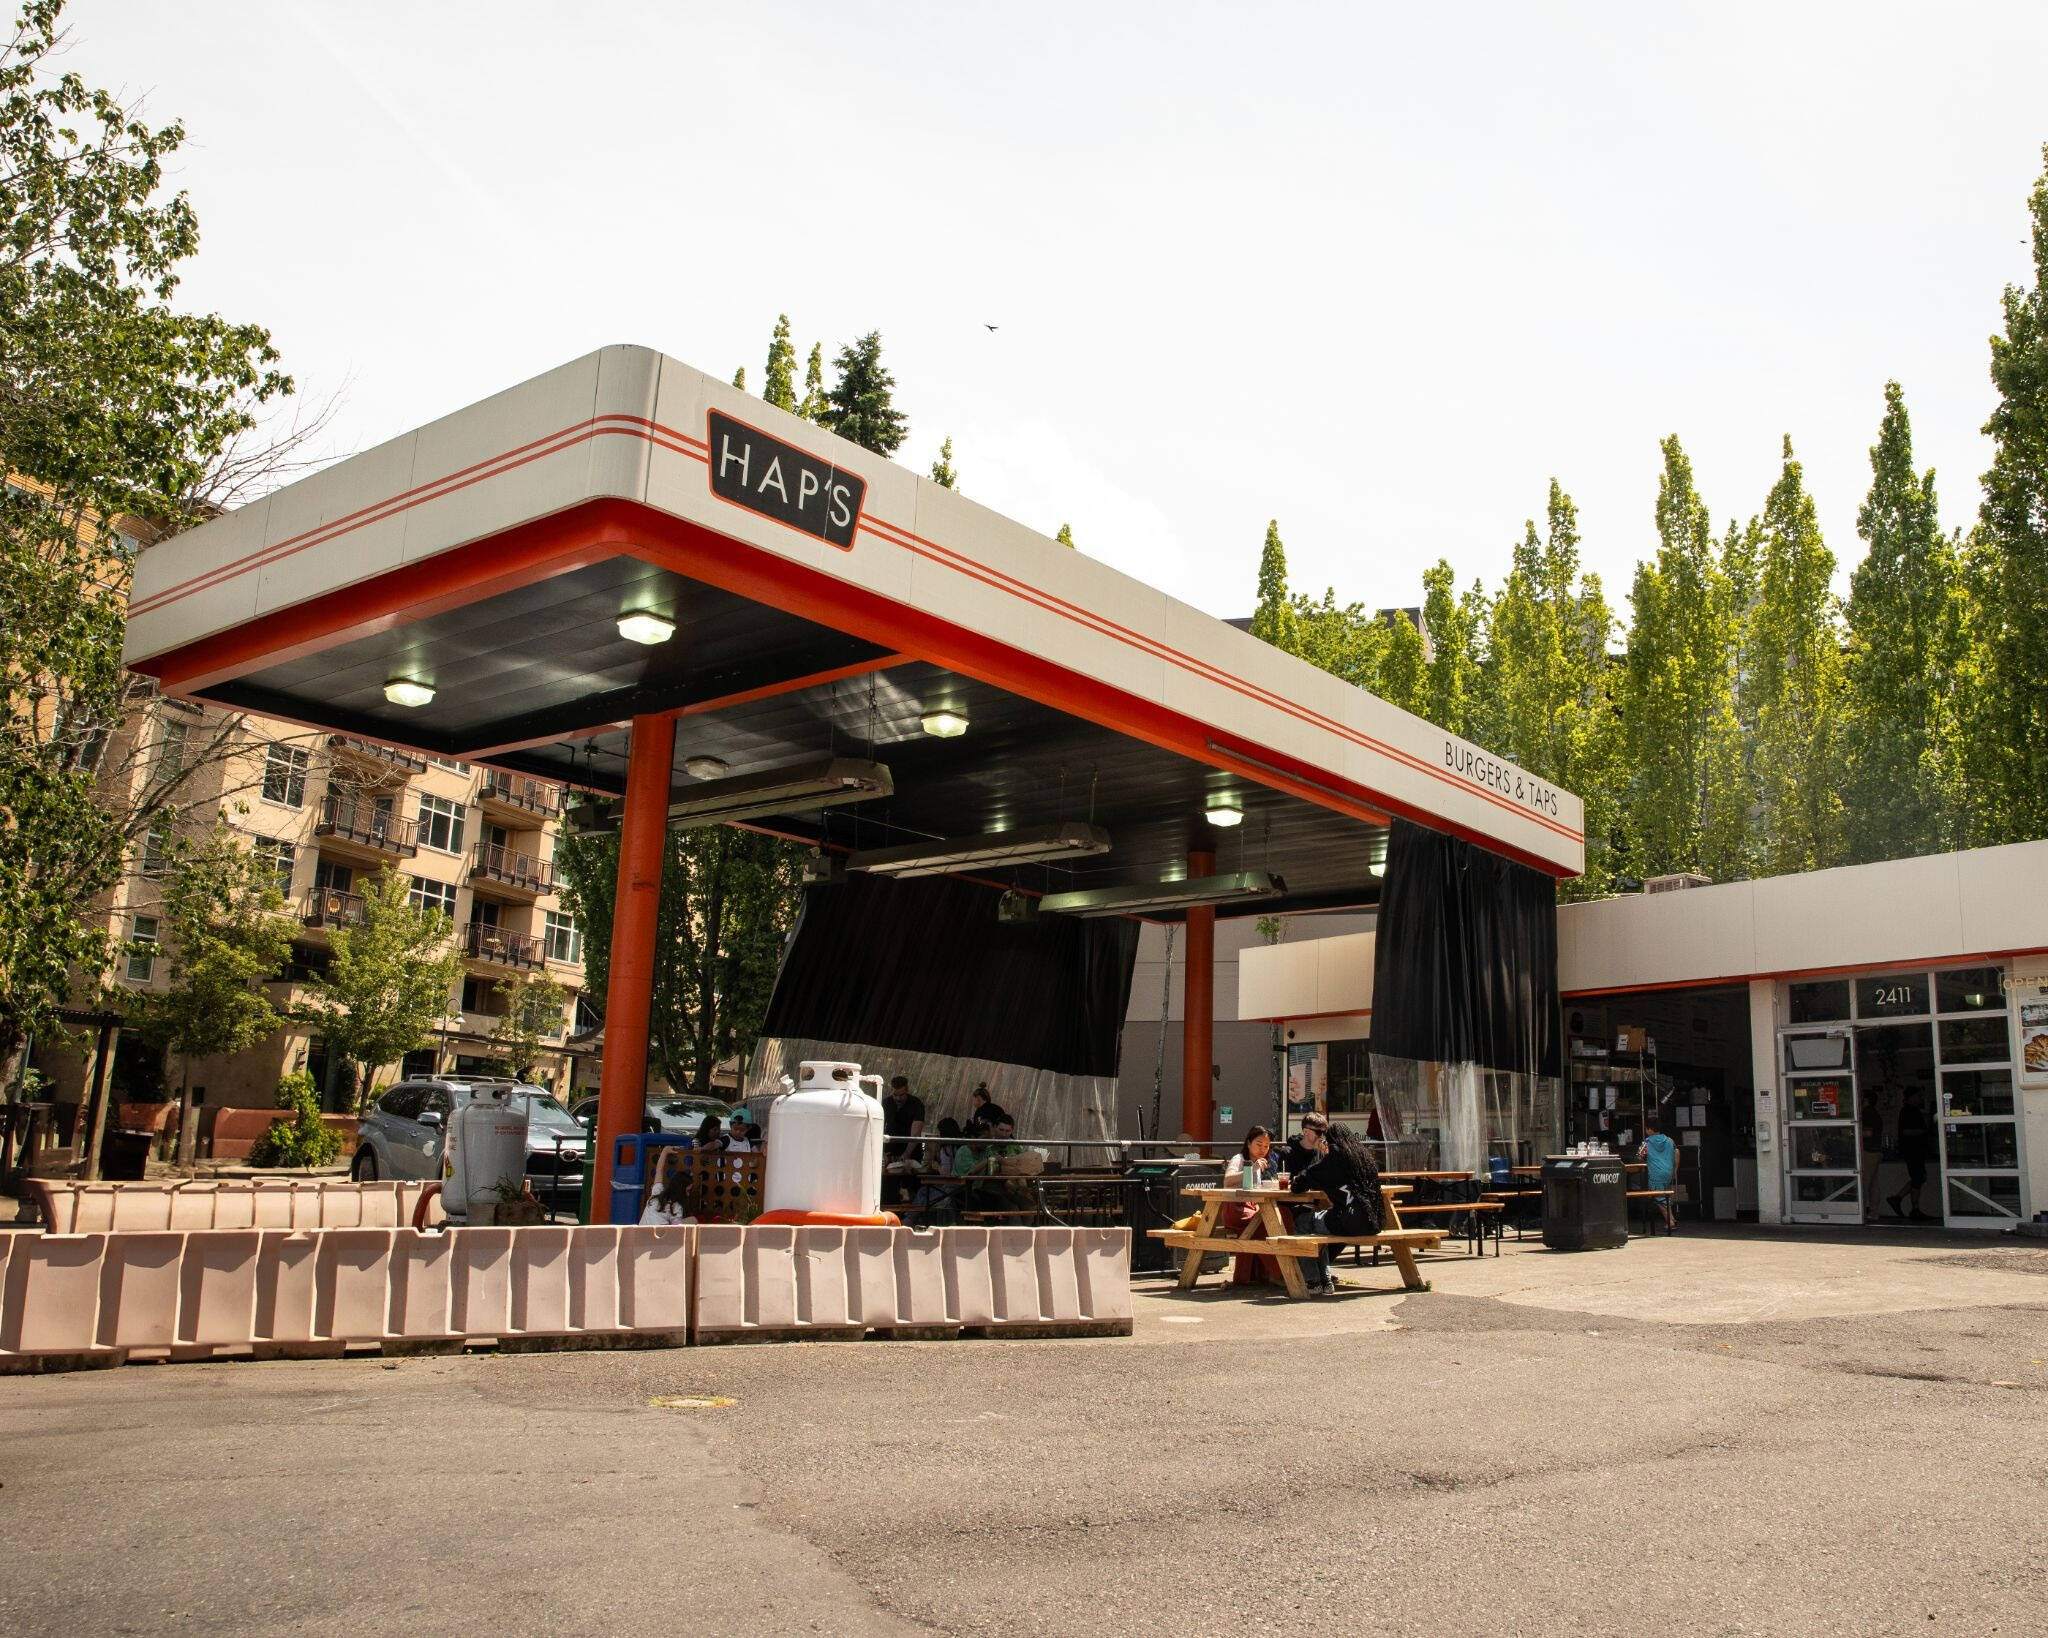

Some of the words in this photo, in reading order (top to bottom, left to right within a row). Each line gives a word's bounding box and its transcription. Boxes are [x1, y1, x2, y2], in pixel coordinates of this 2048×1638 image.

[719, 434, 851, 527] HAP'S
[1445, 741, 1511, 794] BURGERS
[1515, 776, 1524, 800] &
[1529, 782, 1558, 816] TAPS
[2003, 976, 2048, 990] OPEN
[1875, 986, 1911, 1005] 2411
[1593, 1172, 1620, 1184] COMPOST
